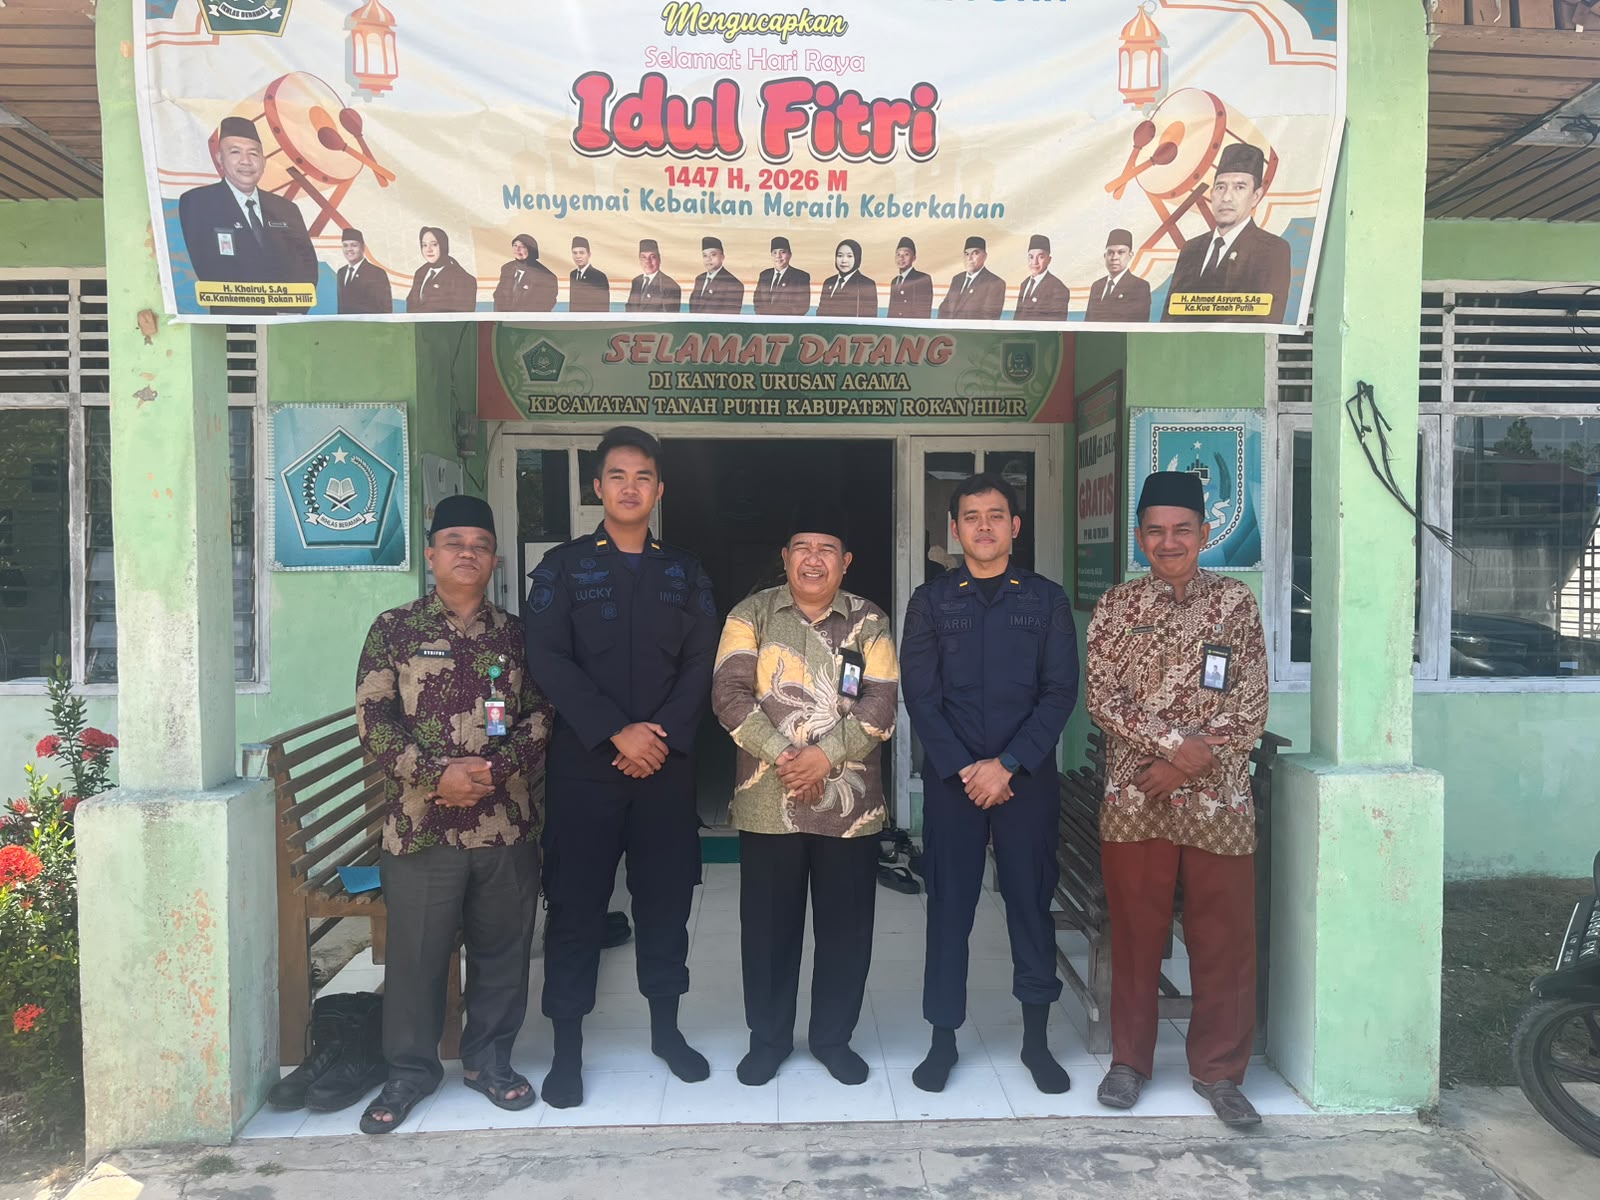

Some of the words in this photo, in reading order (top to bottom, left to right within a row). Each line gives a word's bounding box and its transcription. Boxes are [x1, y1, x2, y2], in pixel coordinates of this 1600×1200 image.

[661, 1, 848, 44] Mengucapkan
[644, 46, 742, 70] Selamat
[747, 48, 798, 71] Hari
[804, 49, 865, 76] Raya
[570, 70, 744, 156] Idul
[758, 75, 940, 162] Fitri
[664, 165, 719, 188] 1447
[727, 167, 751, 193] H,
[758, 168, 819, 191] 2026
[828, 169, 848, 192] M
[502, 184, 631, 219] Menyemai
[639, 187, 753, 216] Kebaikan
[764, 191, 850, 218] Meraih
[860, 193, 1005, 219] Keberkahan
[199, 293, 266, 304] Ka.Kankemenag
[268, 294, 294, 304] Rokan
[295, 295, 314, 303] Hilir
[223, 284, 233, 293] H.
[234, 285, 268, 294] Khairul,
[269, 285, 288, 294] S.Ag
[1180, 295, 1189, 303] H.
[1190, 295, 1216, 303] Ahmad
[1244, 295, 1261, 304] S.Ag
[1212, 304, 1234, 312] Tanah
[1234, 304, 1254, 312] Putih
[603, 332, 793, 367] SELAMAT
[798, 334, 957, 367] DATANG
[648, 371, 672, 391] DI
[675, 371, 756, 392] KANTOR
[759, 372, 837, 392] URUSAN
[840, 373, 911, 392] AGAMA
[527, 394, 650, 415] KECAMATAN
[652, 396, 719, 416] TANAH
[722, 397, 782, 416] PUTIH
[785, 397, 898, 417] KABUPATEN
[901, 397, 970, 417] ROKAN
[971, 397, 1028, 417] HILIR
[1079, 472, 1114, 520] GRATIS
[575, 586, 613, 601] LUCKY
[1010, 614, 1047, 629] IMIPAS
